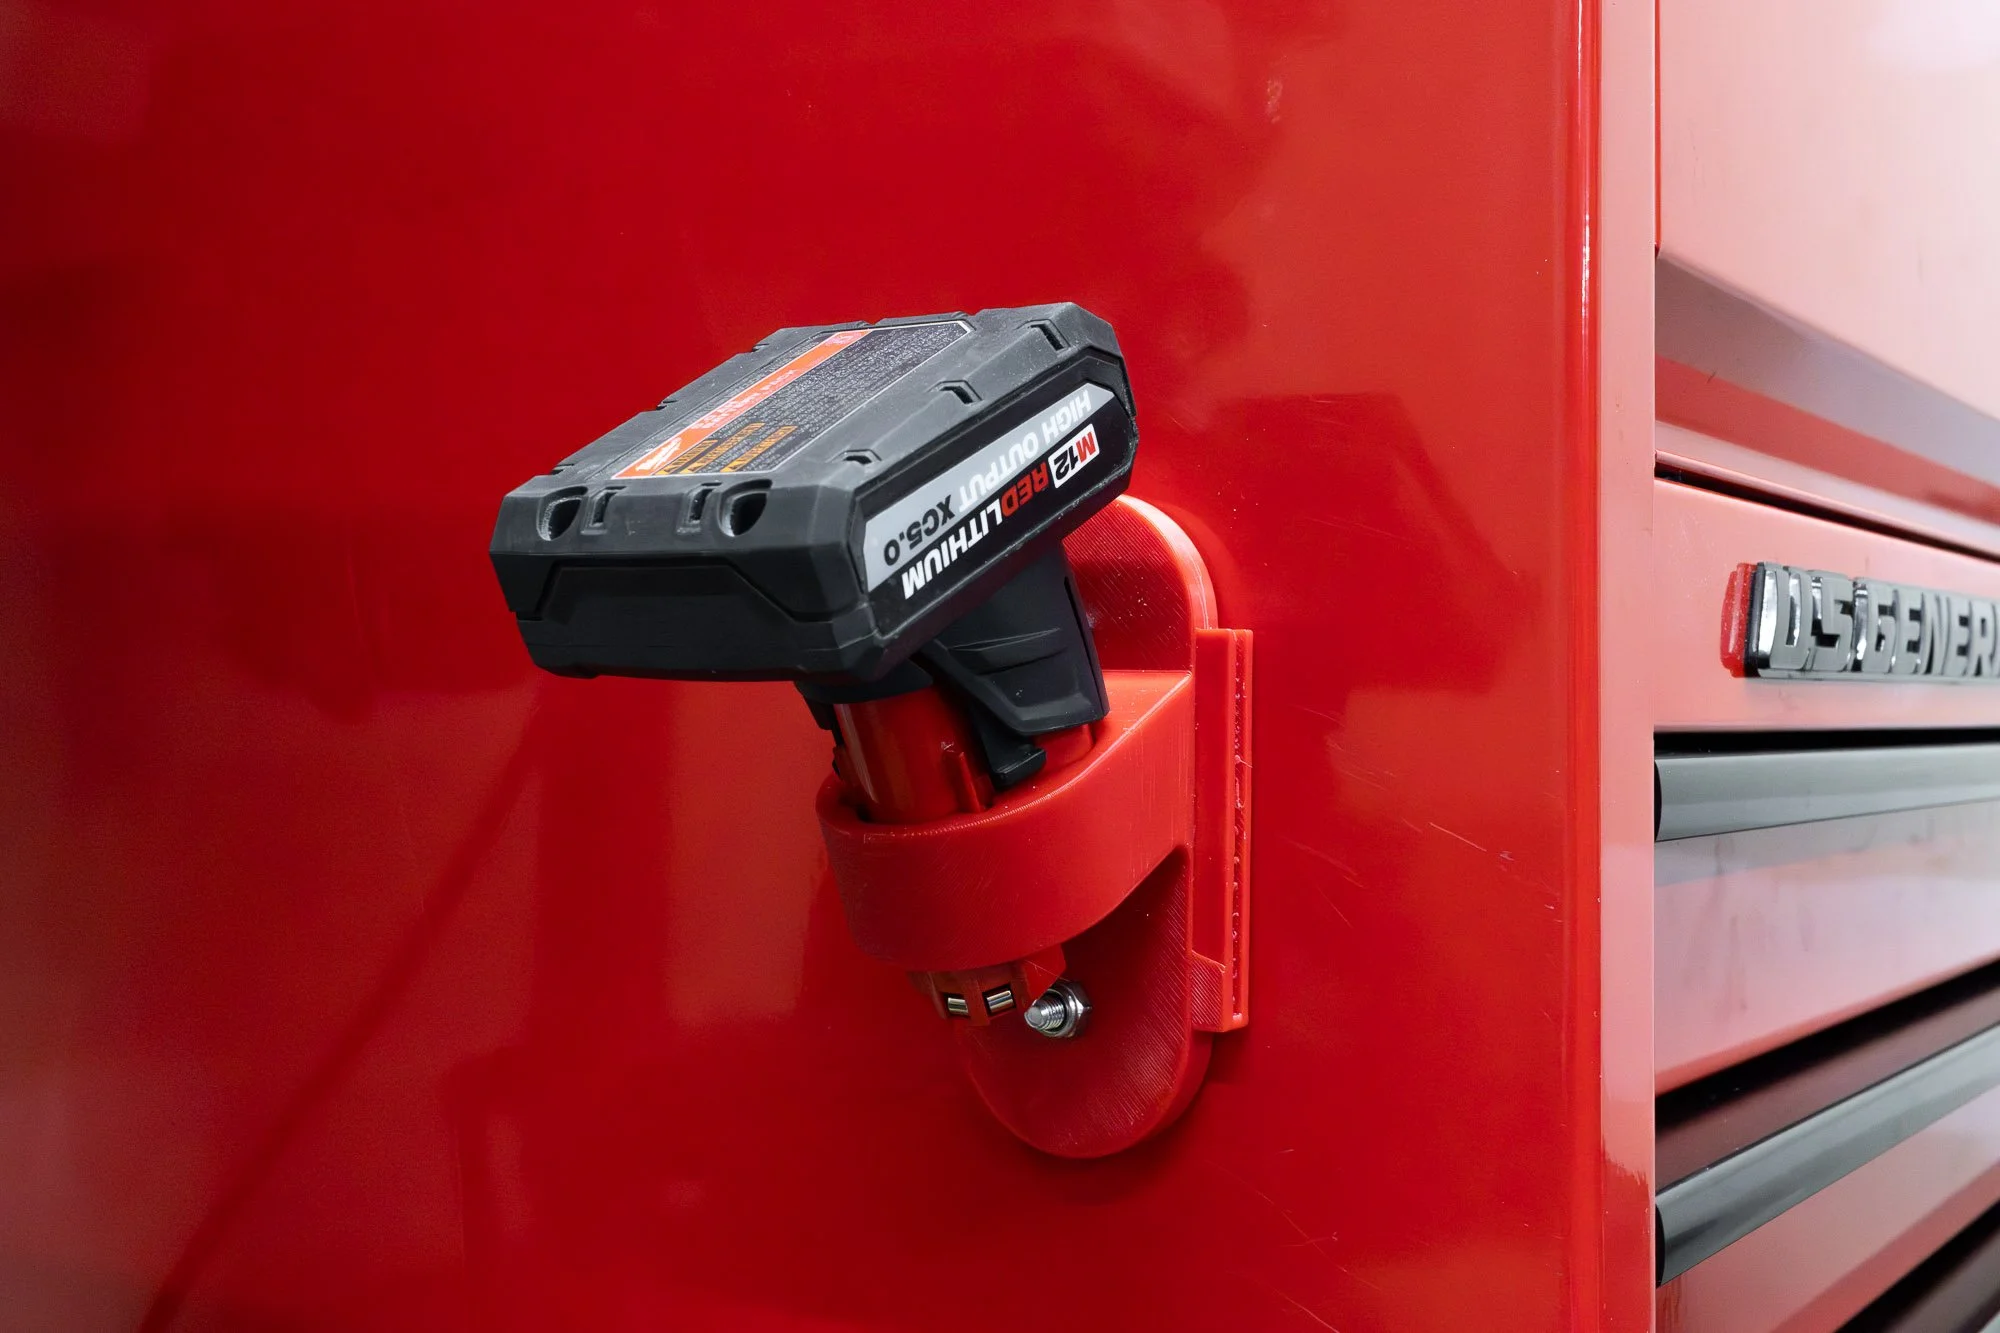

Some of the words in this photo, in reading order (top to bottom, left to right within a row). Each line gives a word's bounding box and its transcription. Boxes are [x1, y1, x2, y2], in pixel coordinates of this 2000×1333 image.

[1041, 389, 1092, 446] HIGH
[958, 437, 1039, 513] OUTPUT
[1054, 431, 1097, 479] M12
[883, 495, 956, 567] XC5.0
